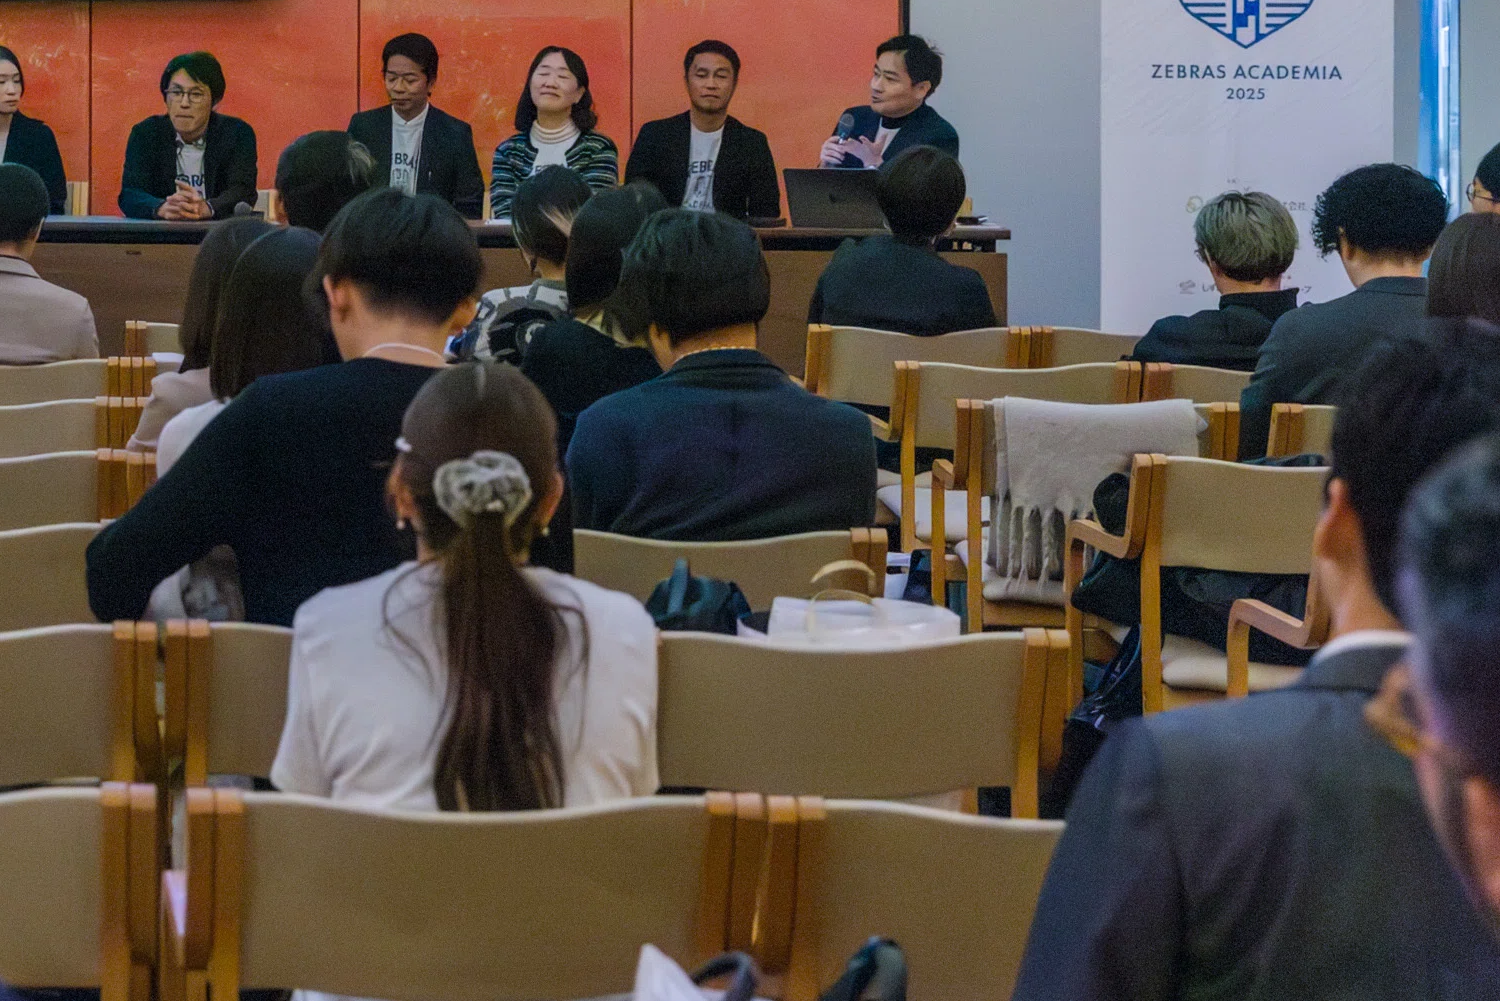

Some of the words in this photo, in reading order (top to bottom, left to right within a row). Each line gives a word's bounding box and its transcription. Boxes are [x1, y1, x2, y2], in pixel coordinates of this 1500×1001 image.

[1151, 64, 1227, 80] ZEBRAS
[1233, 64, 1343, 81] ACADEMIA
[1225, 87, 1266, 101] 2025
